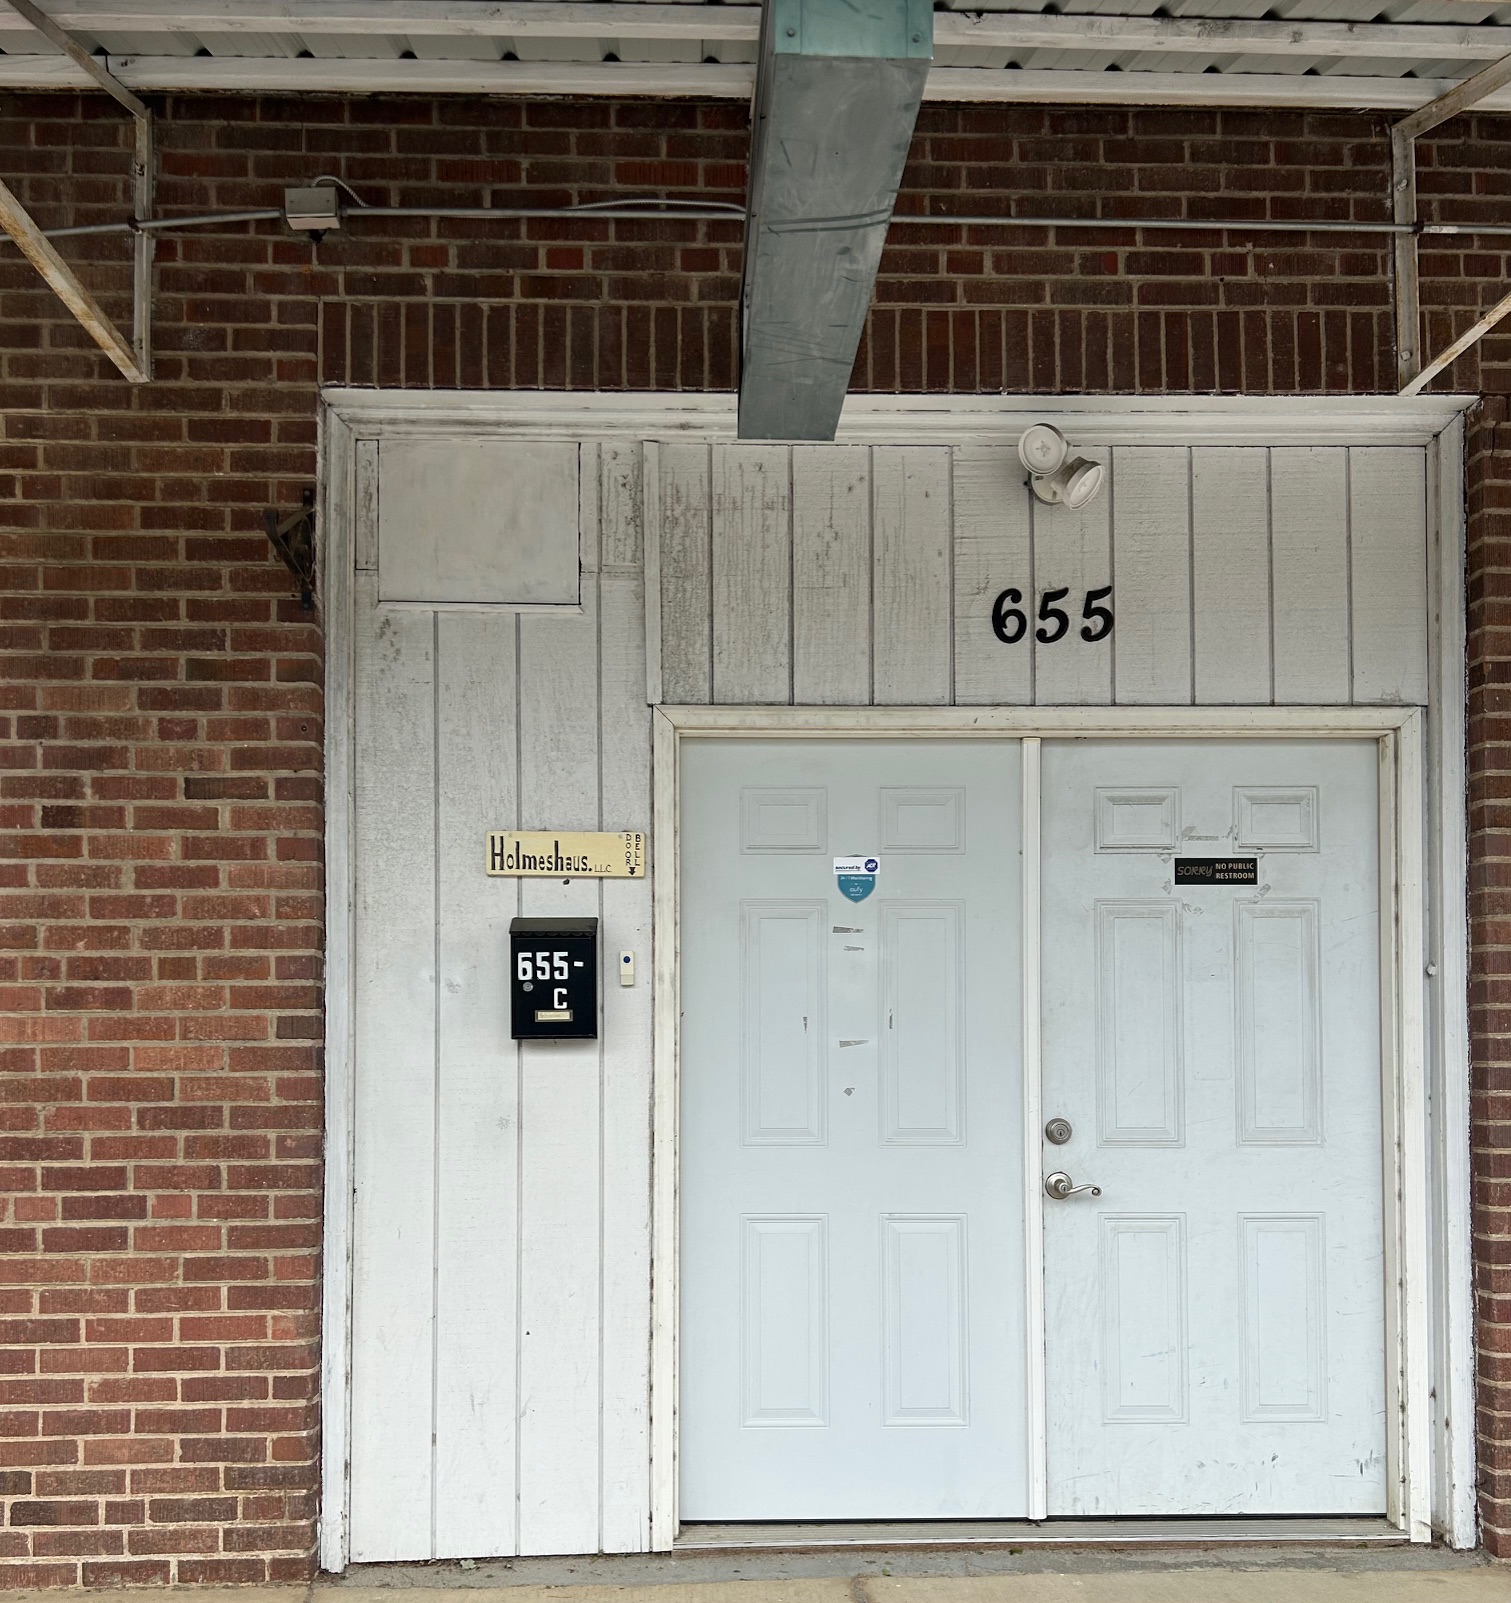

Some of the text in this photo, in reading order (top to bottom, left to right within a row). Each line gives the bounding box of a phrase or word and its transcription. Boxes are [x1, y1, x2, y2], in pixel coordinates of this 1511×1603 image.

[992, 585, 1115, 644] 655
[634, 833, 642, 867] BELL
[517, 951, 584, 981] 655-
[553, 987, 568, 1009] C
